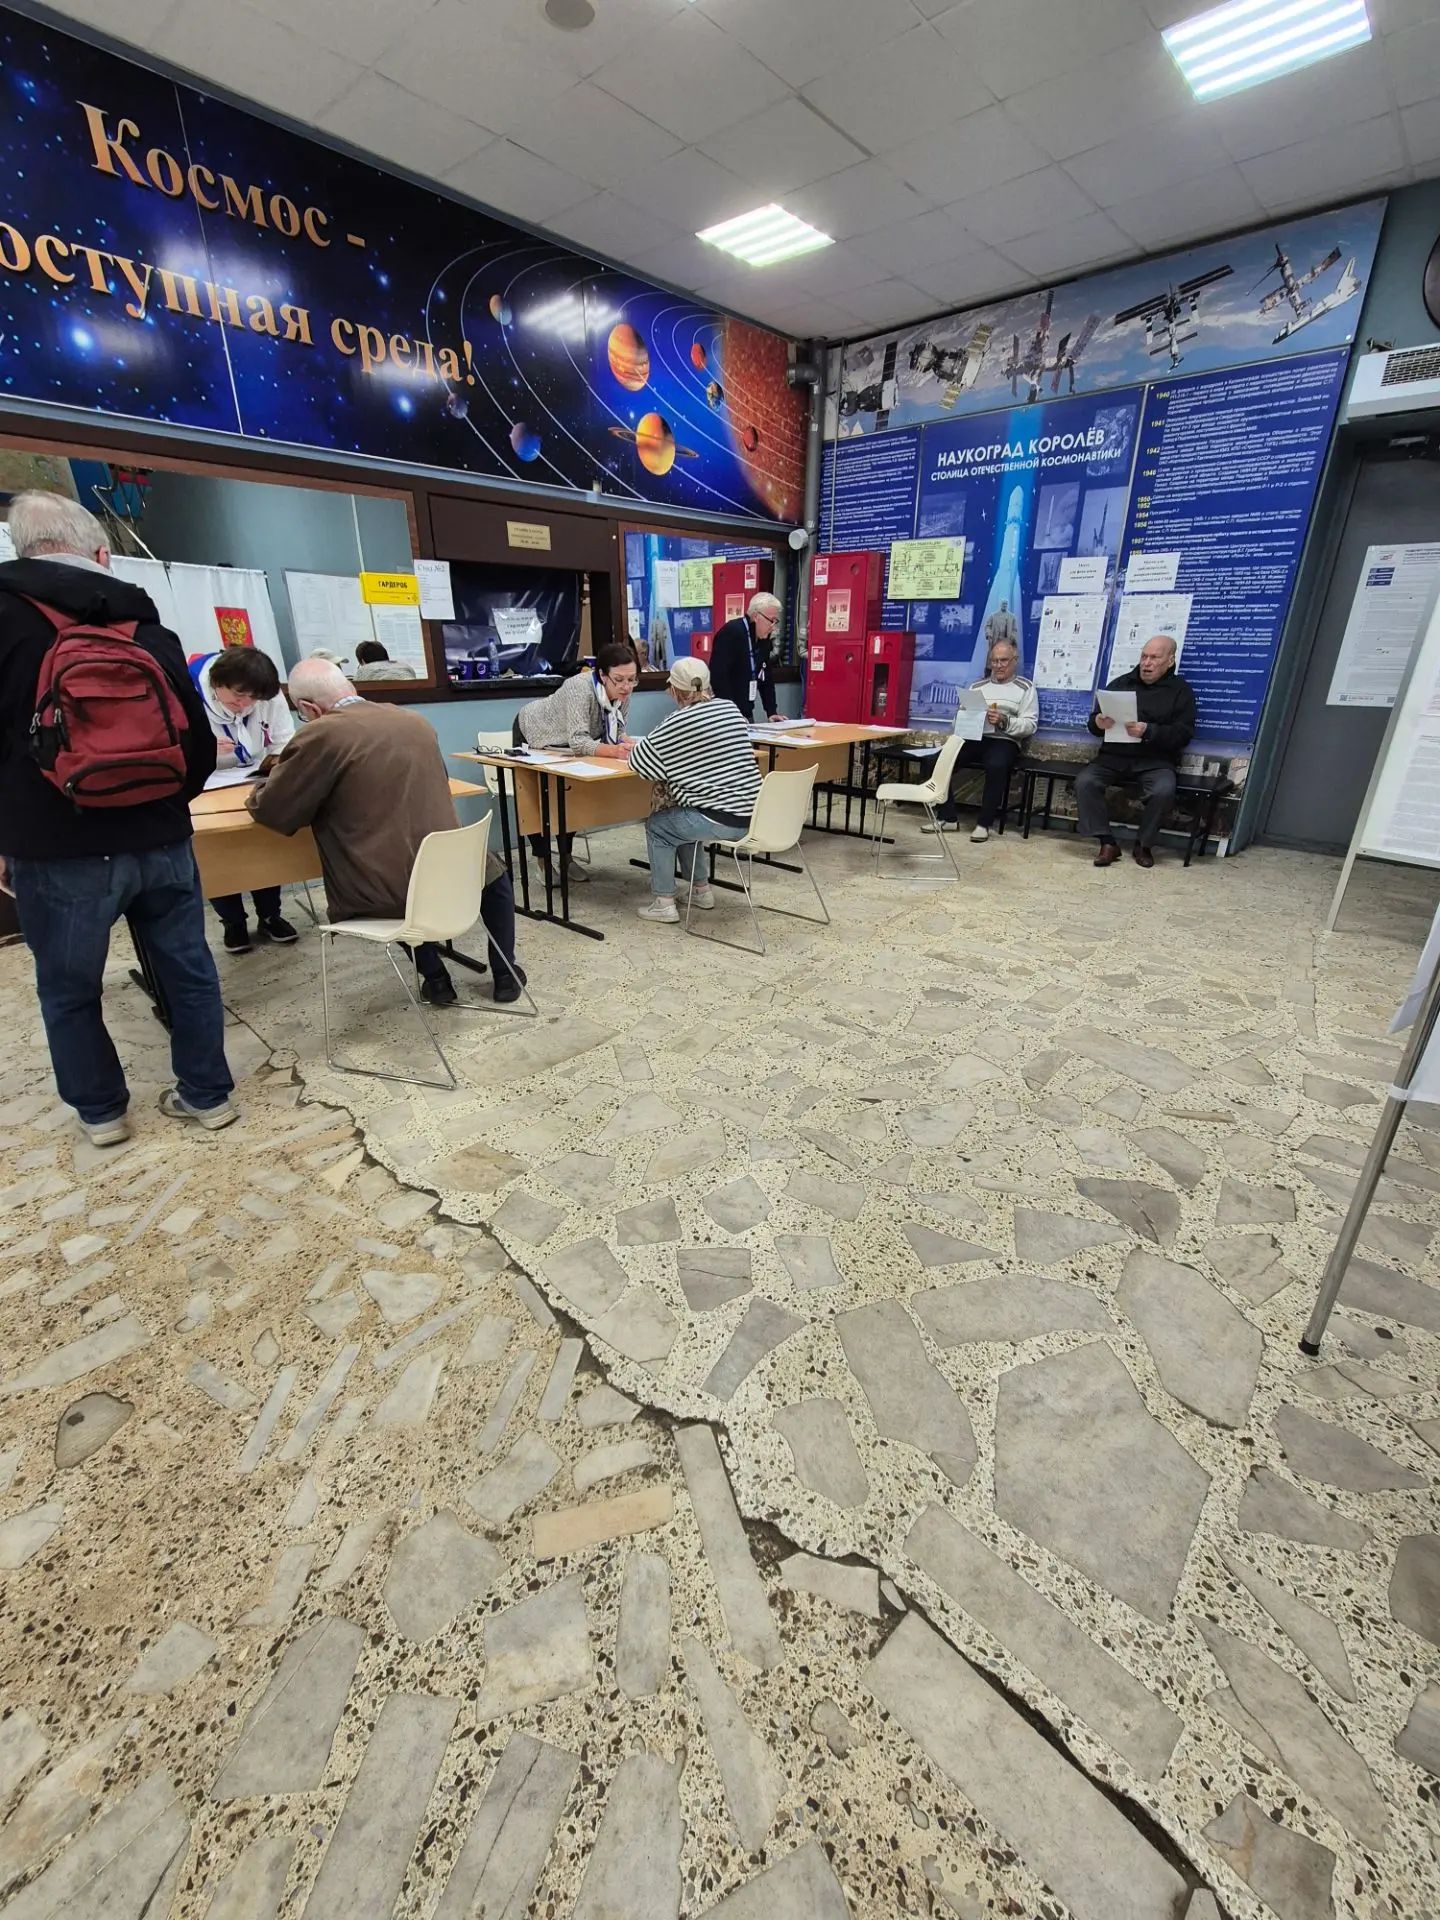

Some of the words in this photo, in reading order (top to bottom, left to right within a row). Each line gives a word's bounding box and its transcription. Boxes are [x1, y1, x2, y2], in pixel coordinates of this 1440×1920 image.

[76, 100, 331, 247] Космос
[0, 221, 314, 345] оступная
[330, 317, 476, 386] среда!
[1151, 419, 1165, 428] 1941
[930, 469, 969, 482] СТОЛИЦА
[970, 459, 1039, 476] ОТЕЧЕСТВЕННОЙ
[1040, 448, 1122, 467] КОСМОНАВТИКИ
[937, 441, 1024, 467] НАУКОГРАД
[1028, 427, 1105, 455] КОРОЛЁВ
[378, 580, 408, 590] ГАРДЕРОБ
